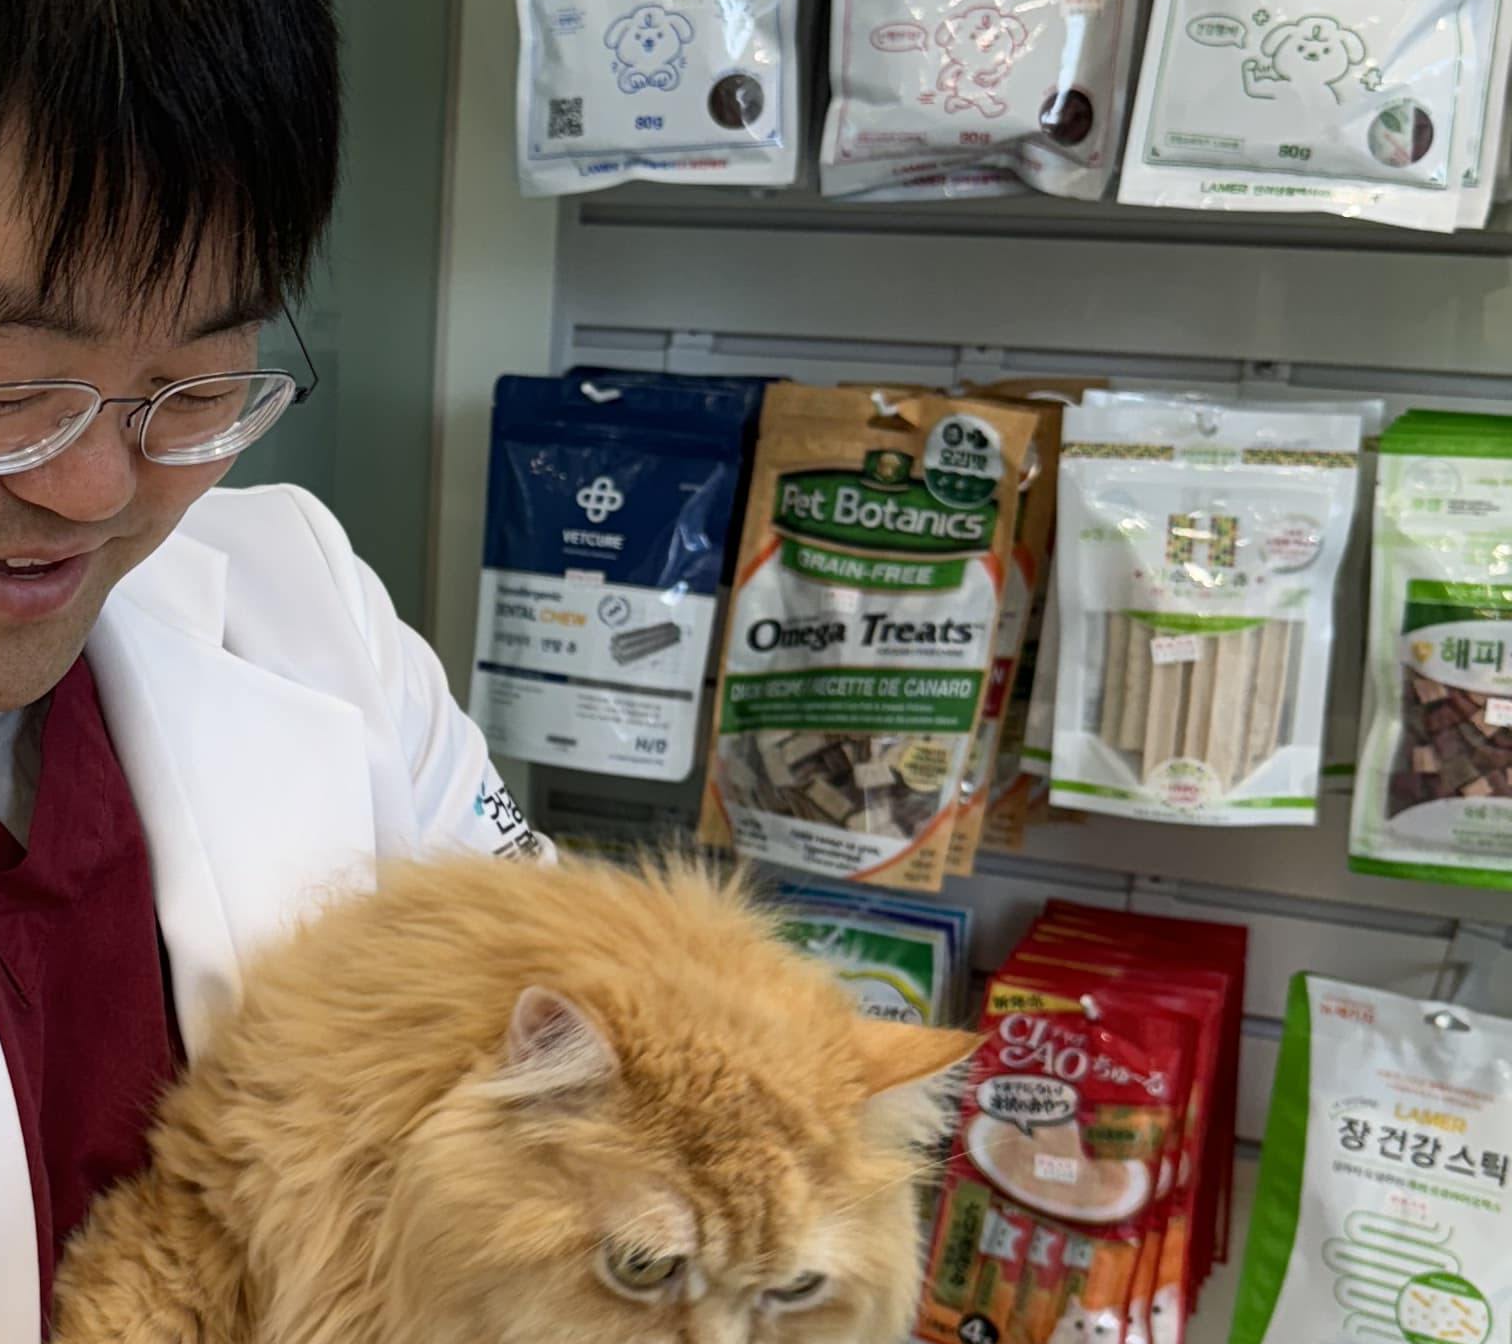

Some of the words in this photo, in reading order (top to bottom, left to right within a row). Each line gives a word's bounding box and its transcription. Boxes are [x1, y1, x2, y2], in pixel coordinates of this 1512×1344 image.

[780, 483, 826, 523] Pet
[832, 485, 986, 540] Botanics
[798, 549, 935, 586] GRAIN-FREE
[747, 617, 847, 653] Omega
[860, 612, 973, 648] Treats
[903, 678, 973, 698] CANARD
[999, 1012, 1089, 1082] CIAO
[1339, 1116, 1372, 1152] 장
[1377, 1125, 1443, 1169] 건강
[1444, 1143, 1510, 1188] 스틱
